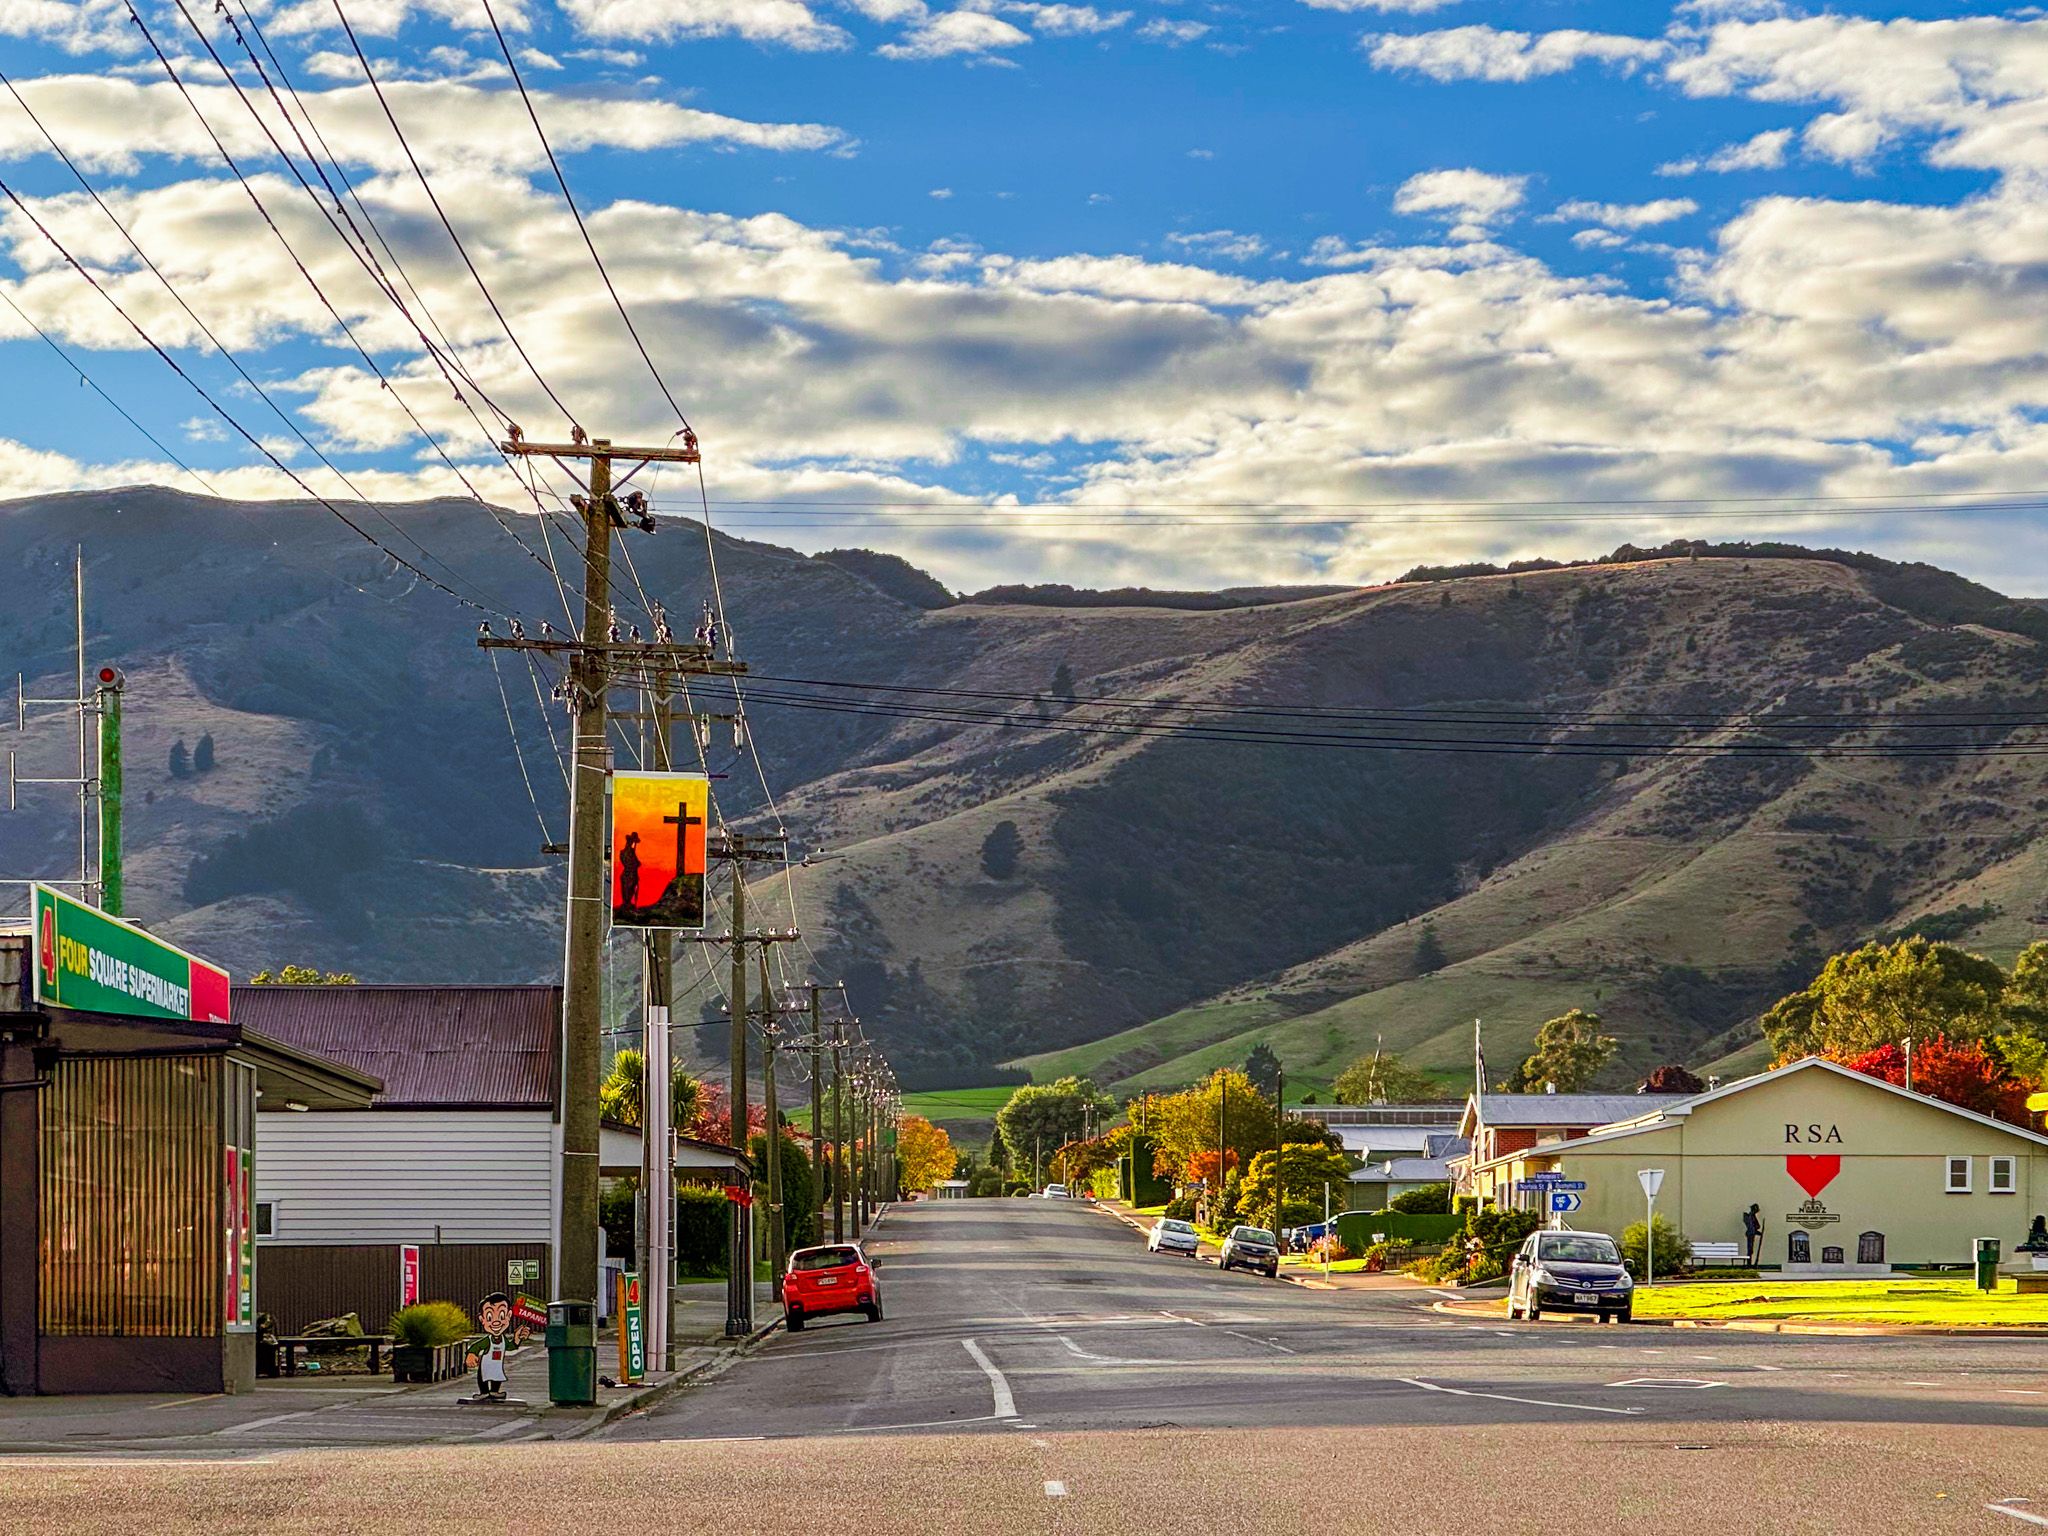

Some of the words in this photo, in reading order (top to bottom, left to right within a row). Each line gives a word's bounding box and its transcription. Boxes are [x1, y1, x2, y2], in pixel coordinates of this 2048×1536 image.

[41, 906, 55, 986] 4
[59, 935, 88, 977] FOUR
[89, 947, 128, 992] SQUARE
[128, 965, 189, 1017] SUPERMARKET
[1784, 1123, 1844, 1144] RSA
[627, 1279, 640, 1305] 4
[630, 1316, 642, 1370] OPEN
